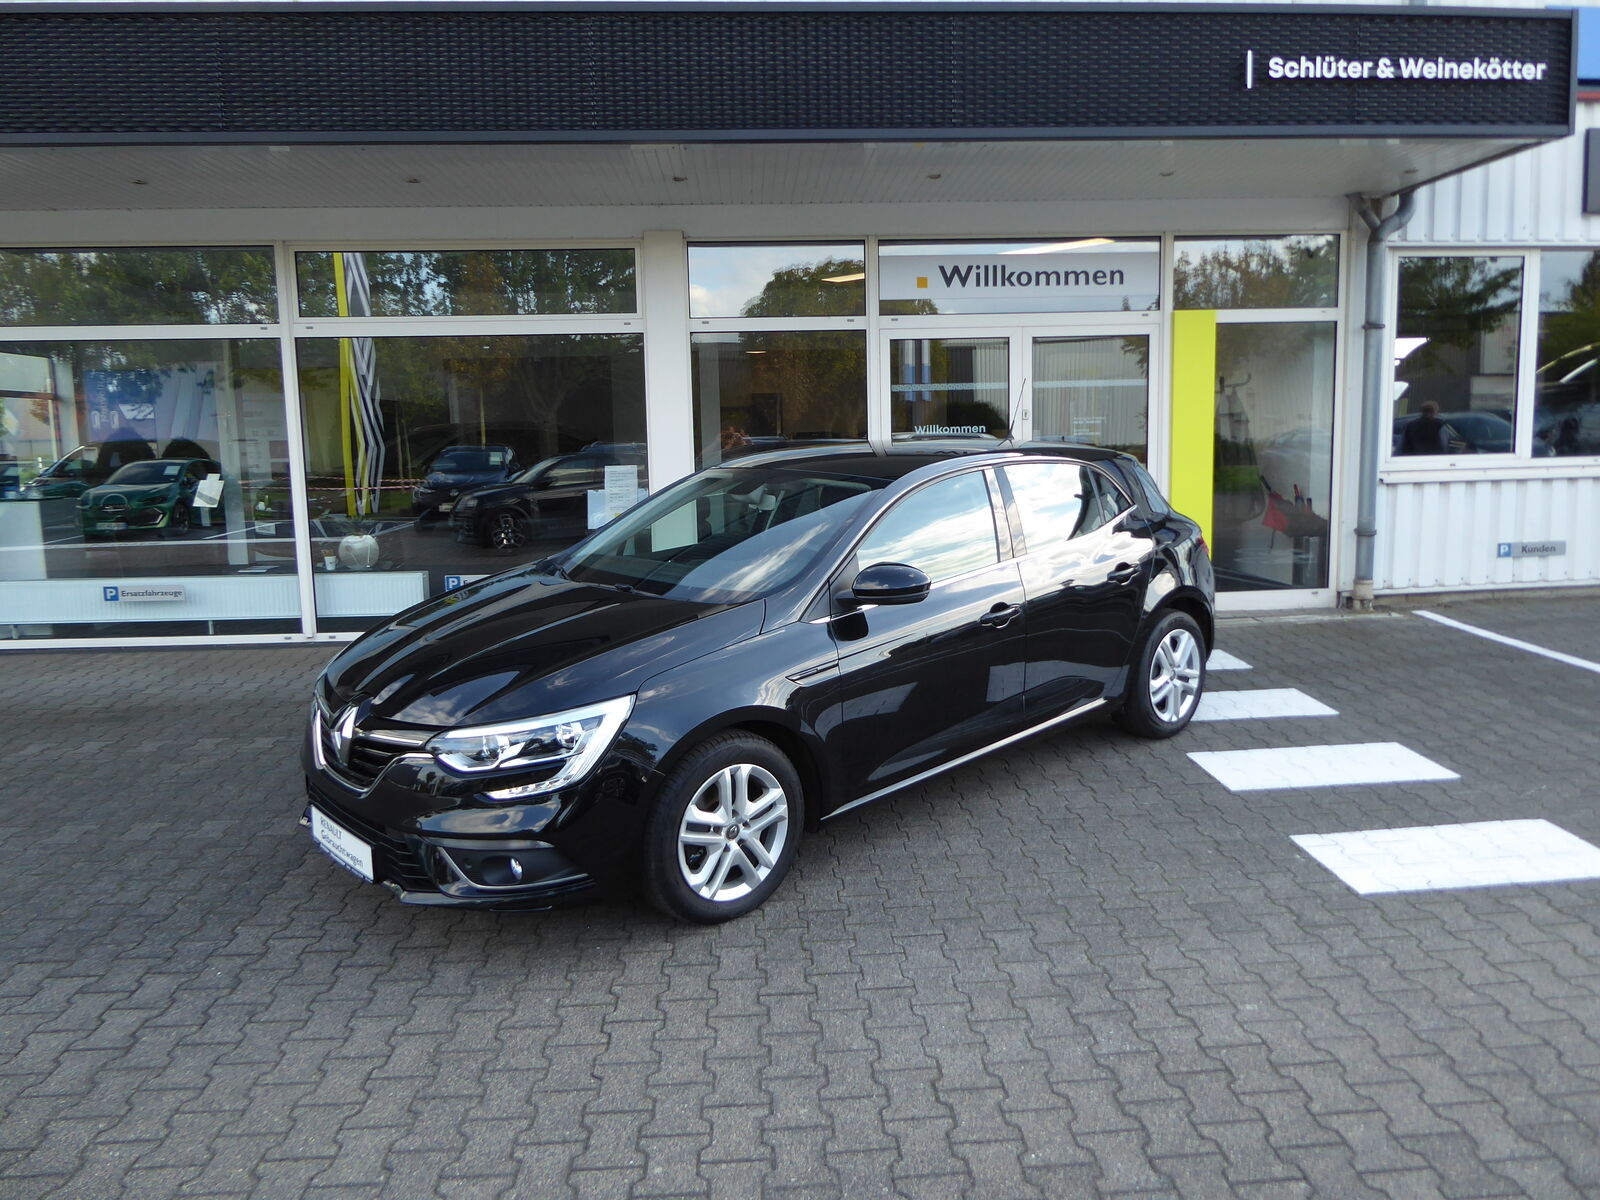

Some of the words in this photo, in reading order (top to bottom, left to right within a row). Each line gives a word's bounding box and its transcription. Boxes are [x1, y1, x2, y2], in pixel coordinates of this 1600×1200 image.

[1268, 56, 1373, 79] Schlüter
[1376, 57, 1395, 79] &
[1399, 57, 1547, 80] Weinekötter
[938, 264, 1124, 288] Willkommen
[914, 424, 986, 435] Willkommen
[1521, 544, 1556, 554] Kunden
[121, 589, 183, 598] Ersatzfahrzeuge
[320, 816, 343, 840] RENAULT
[320, 828, 364, 868] Gebrauchtwagen
